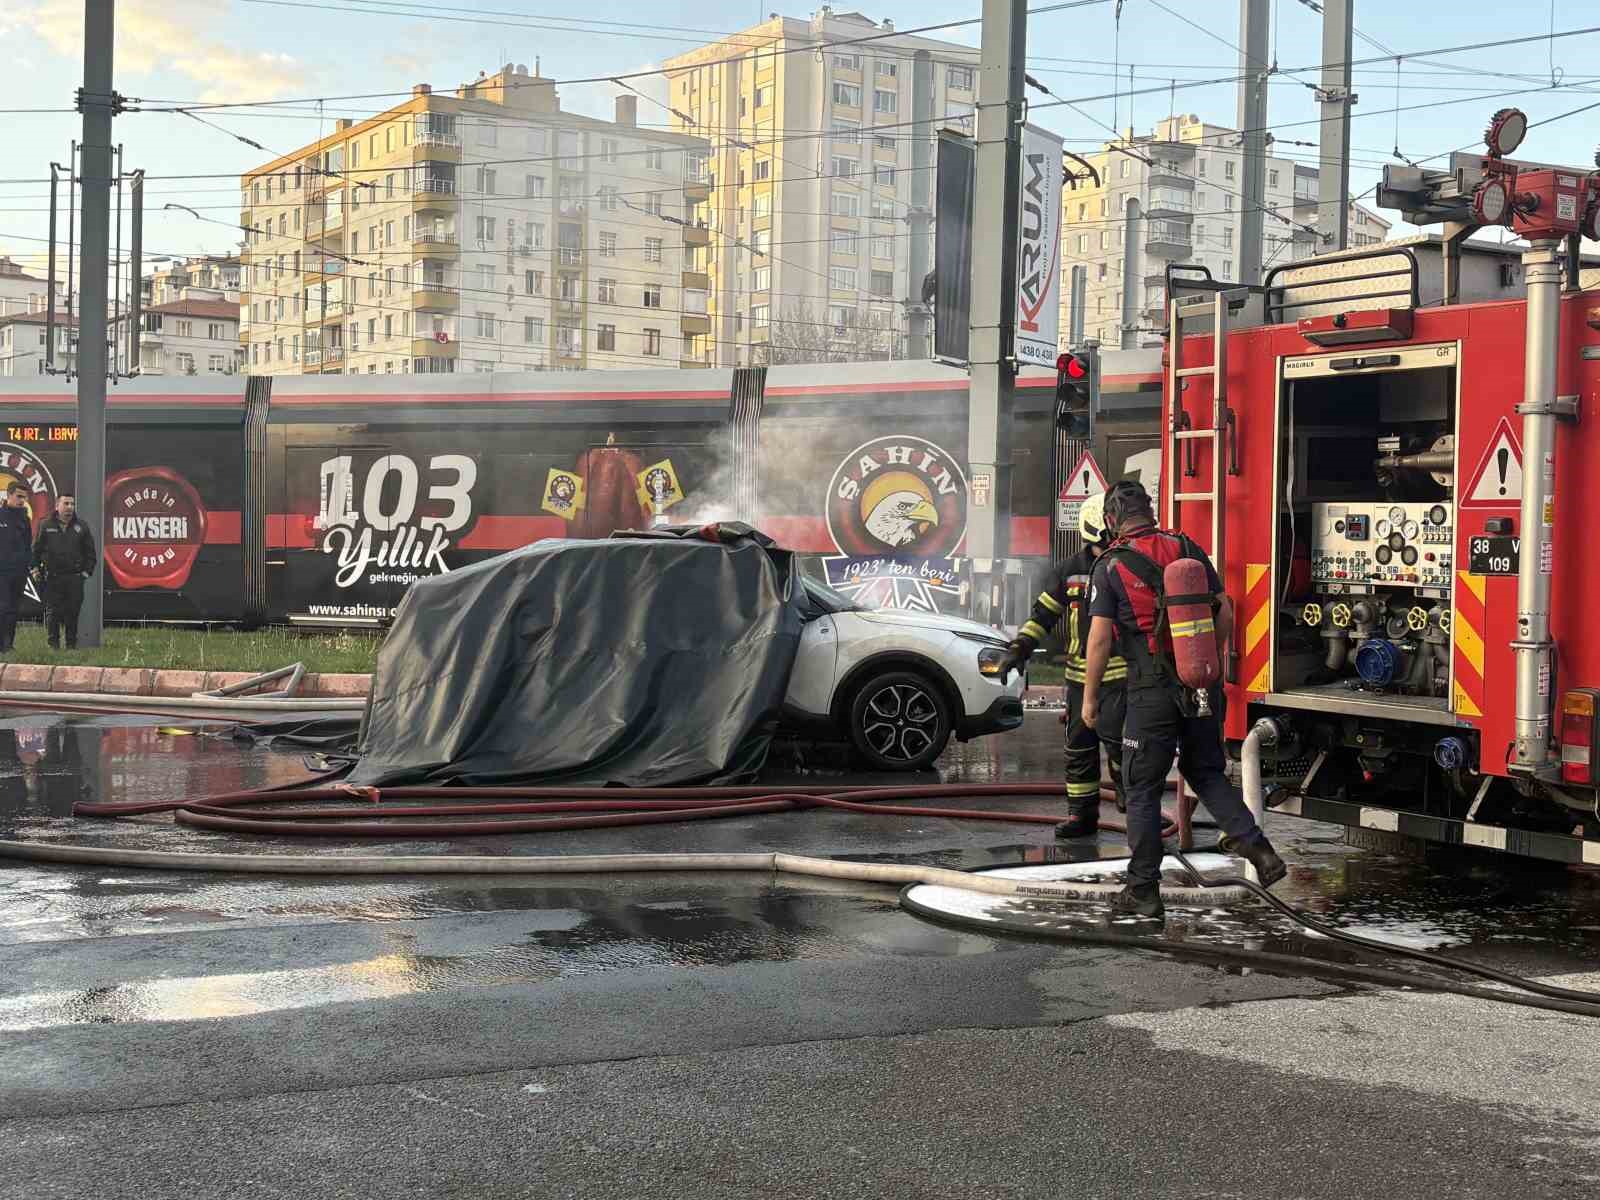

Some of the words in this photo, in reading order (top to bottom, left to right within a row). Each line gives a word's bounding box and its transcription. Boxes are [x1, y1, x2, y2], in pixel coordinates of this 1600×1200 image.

[1020, 153, 1044, 332] KARUM
[124, 487, 158, 509] made
[163, 491, 176, 508] in
[313, 454, 478, 532] 103
[324, 526, 451, 588] Yıllık
[1473, 539, 1490, 554] 38
[888, 560, 916, 576] ten
[921, 561, 955, 582] beri
[1488, 556, 1510, 572] 109
